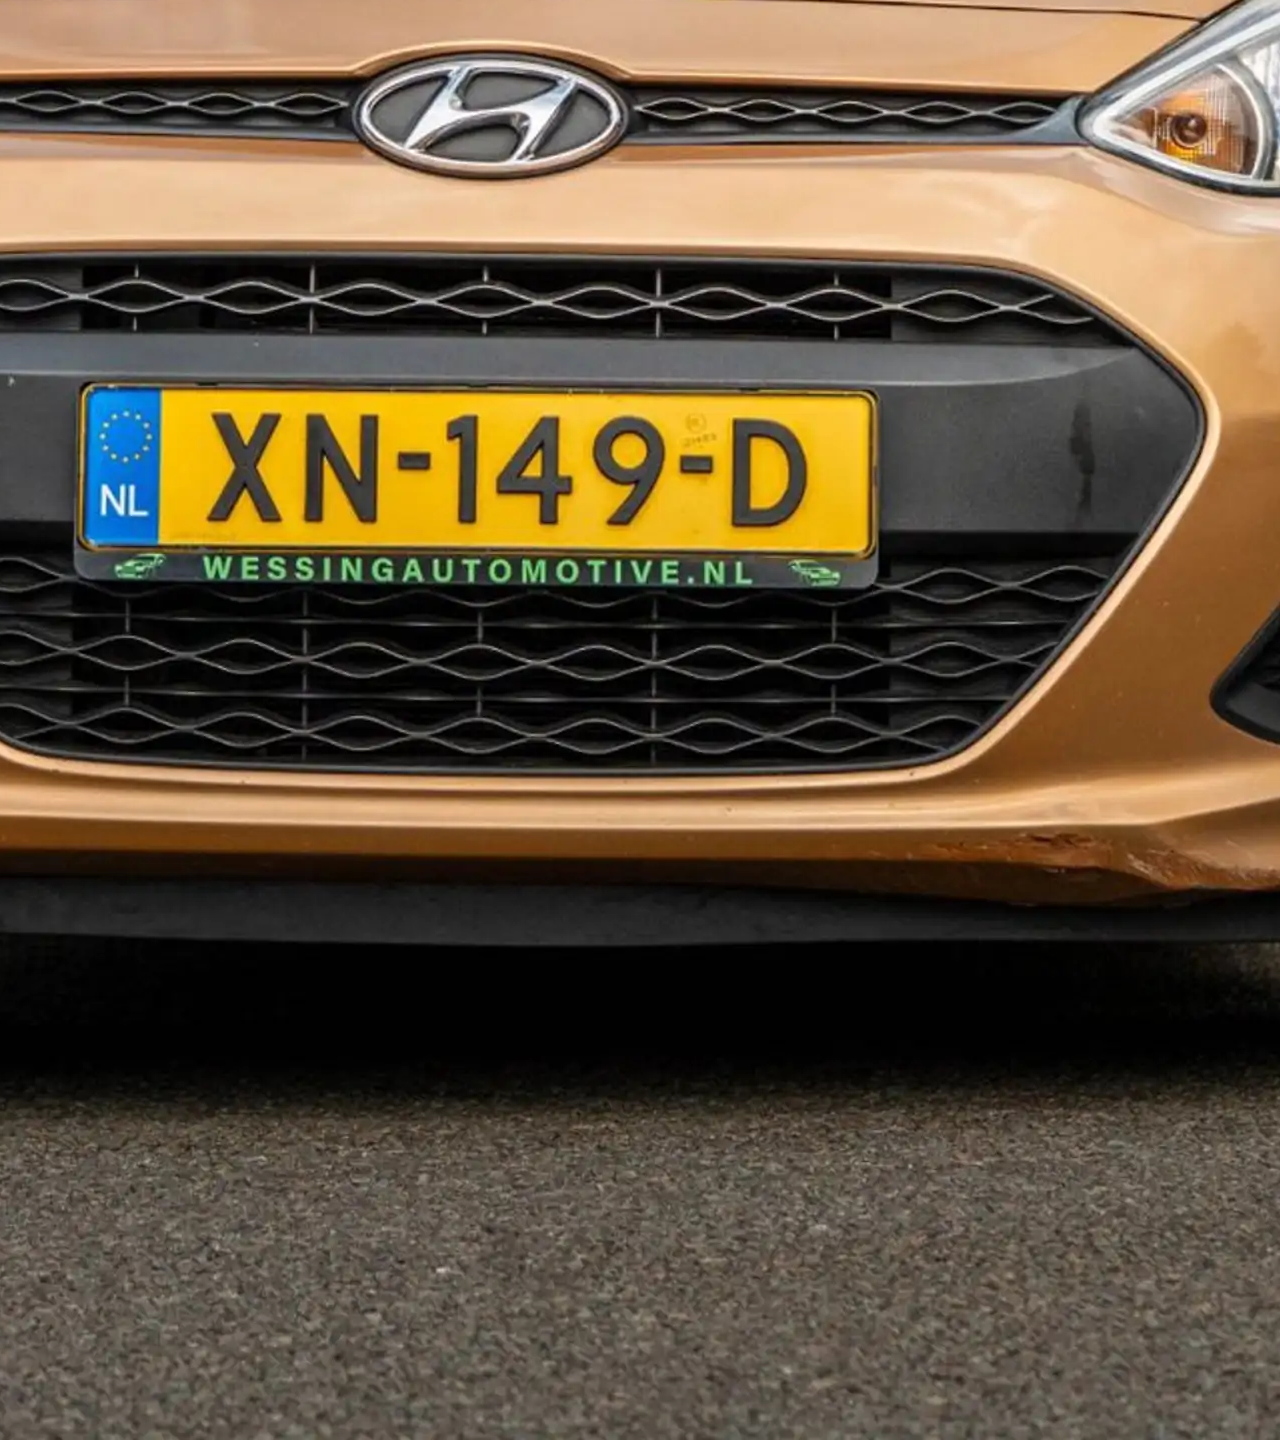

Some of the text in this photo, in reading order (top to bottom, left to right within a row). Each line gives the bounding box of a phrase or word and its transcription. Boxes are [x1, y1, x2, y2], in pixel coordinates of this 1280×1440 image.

[206, 411, 809, 527] XN-149-D
[100, 483, 149, 518] NL
[202, 554, 754, 587] WESSINGAUTOMOTIVE.NL
